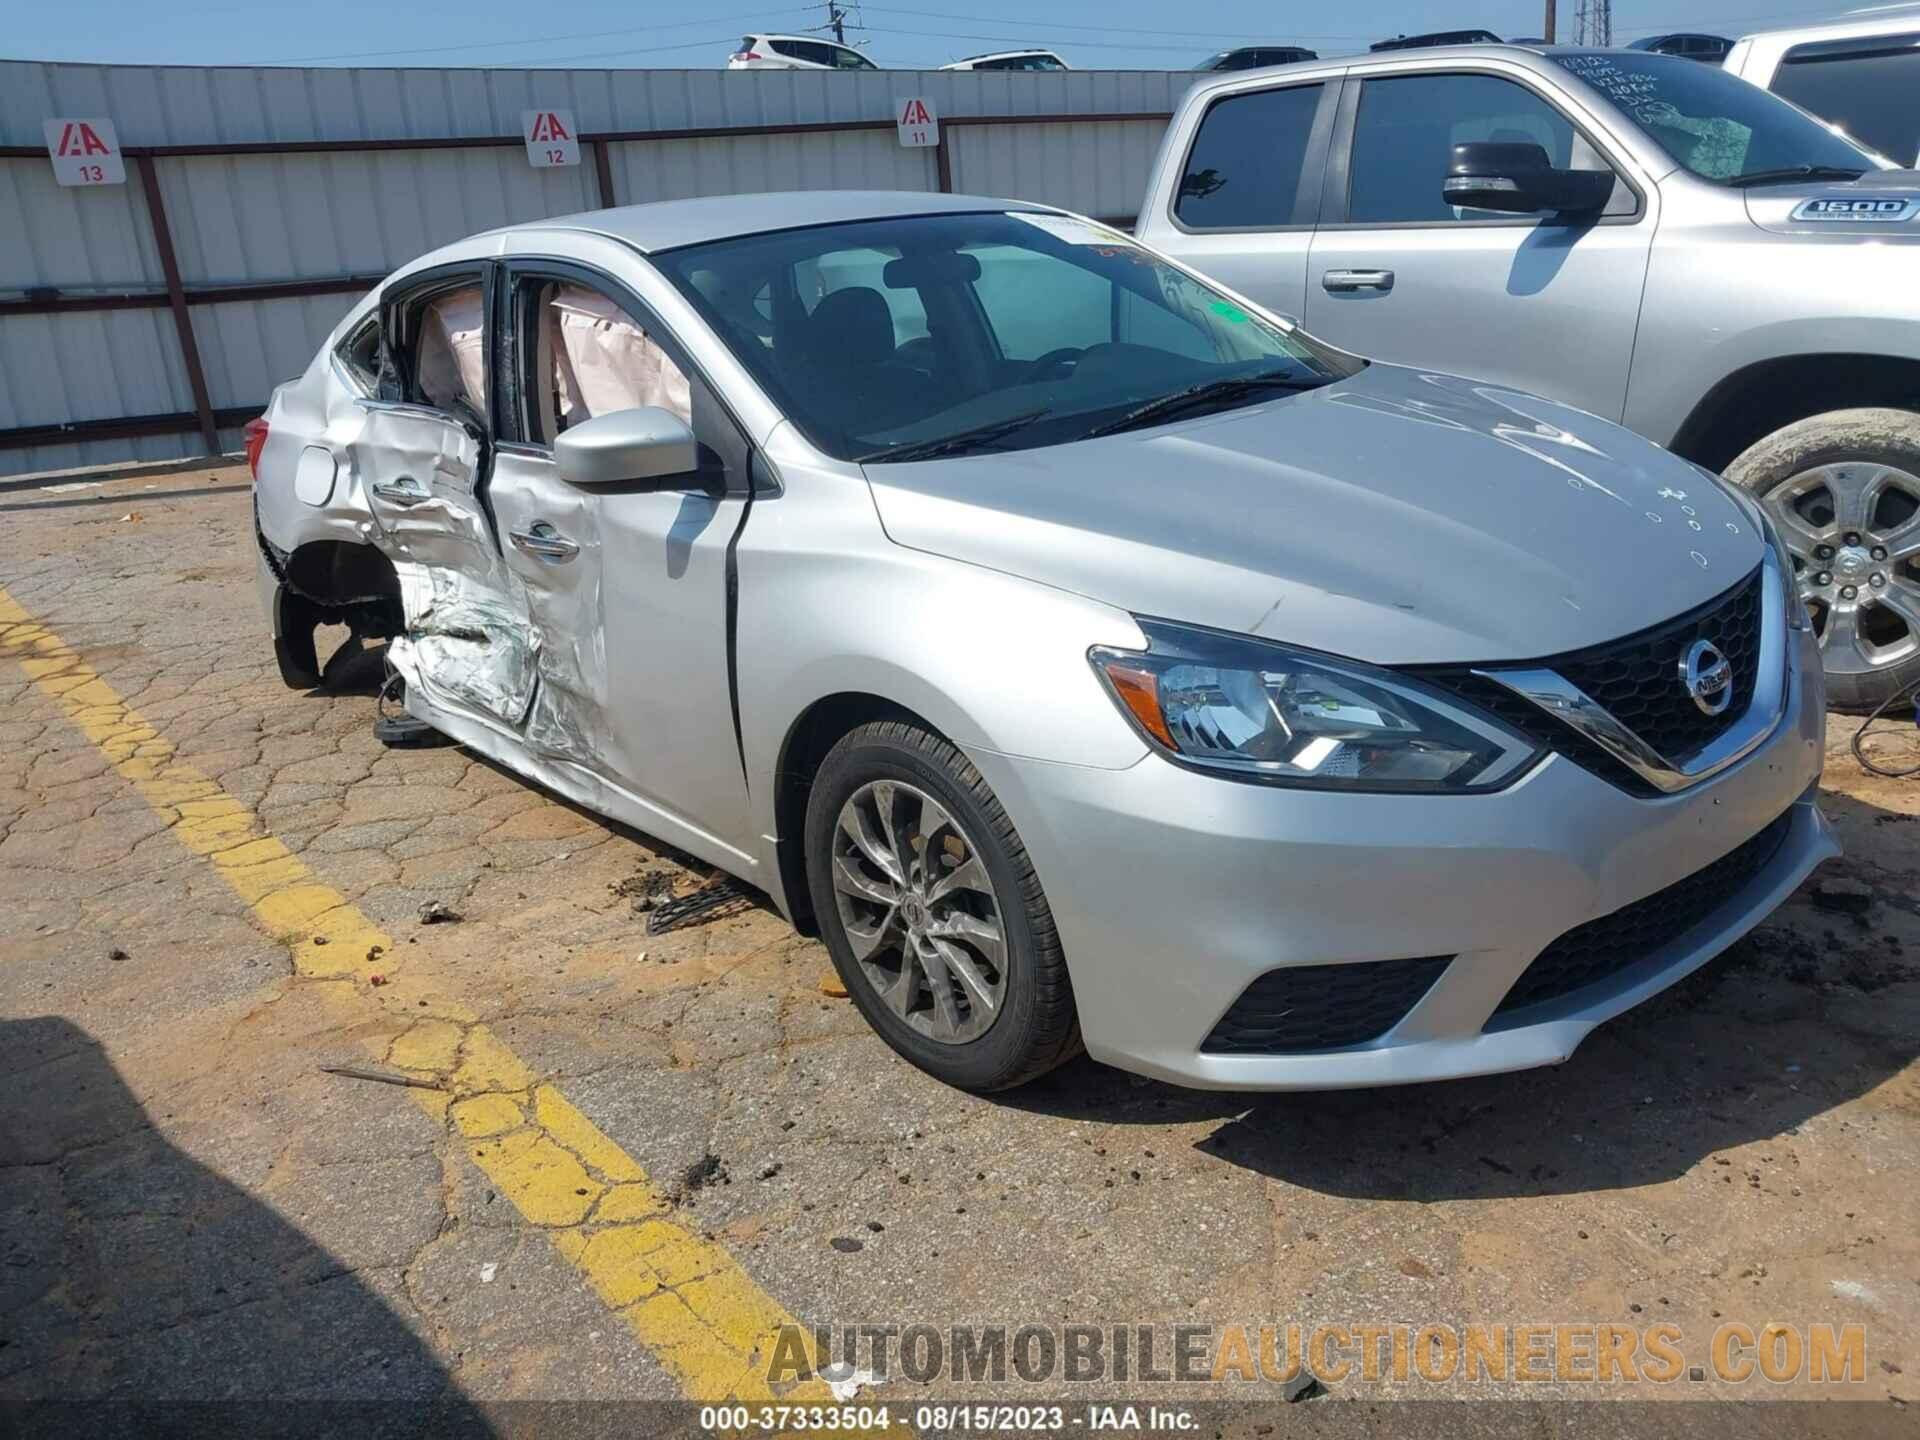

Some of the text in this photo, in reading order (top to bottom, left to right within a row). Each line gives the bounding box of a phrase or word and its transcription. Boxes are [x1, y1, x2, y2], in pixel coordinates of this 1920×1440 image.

[913, 132, 926, 145] 11
[546, 150, 565, 164] 12
[79, 166, 104, 182] 13
[1816, 201, 1903, 213] 1500
